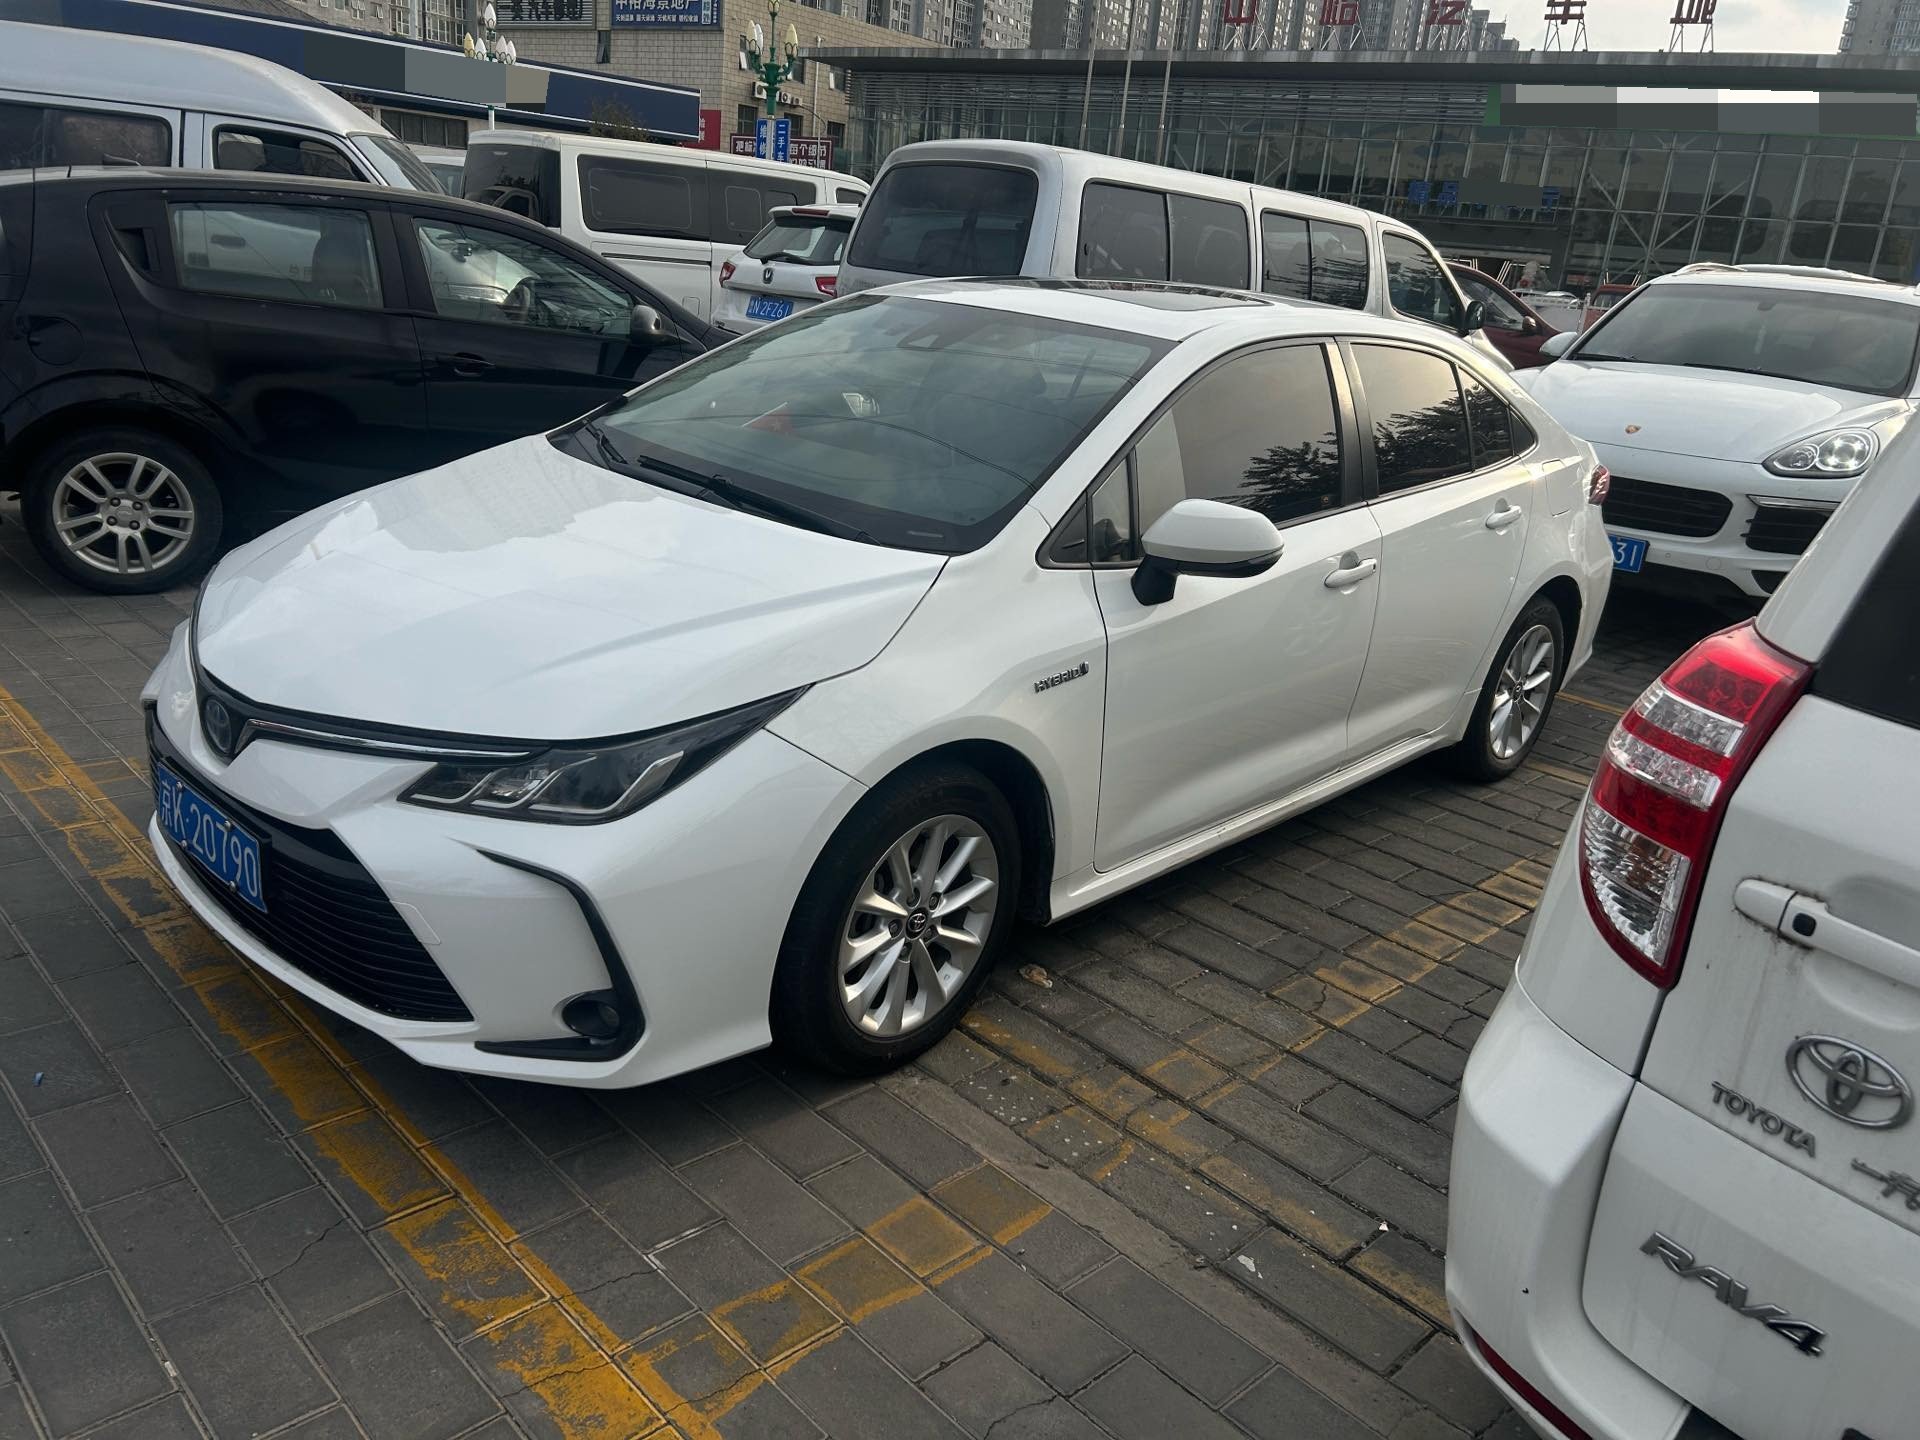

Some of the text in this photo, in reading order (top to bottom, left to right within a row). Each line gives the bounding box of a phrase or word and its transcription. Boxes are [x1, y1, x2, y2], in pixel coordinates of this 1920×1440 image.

[777, 124, 786, 161] 二手车
[1033, 667, 1080, 694] HYBRID
[1711, 1080, 1816, 1158] TOYOTA
[1640, 1231, 1827, 1357] RAV4
